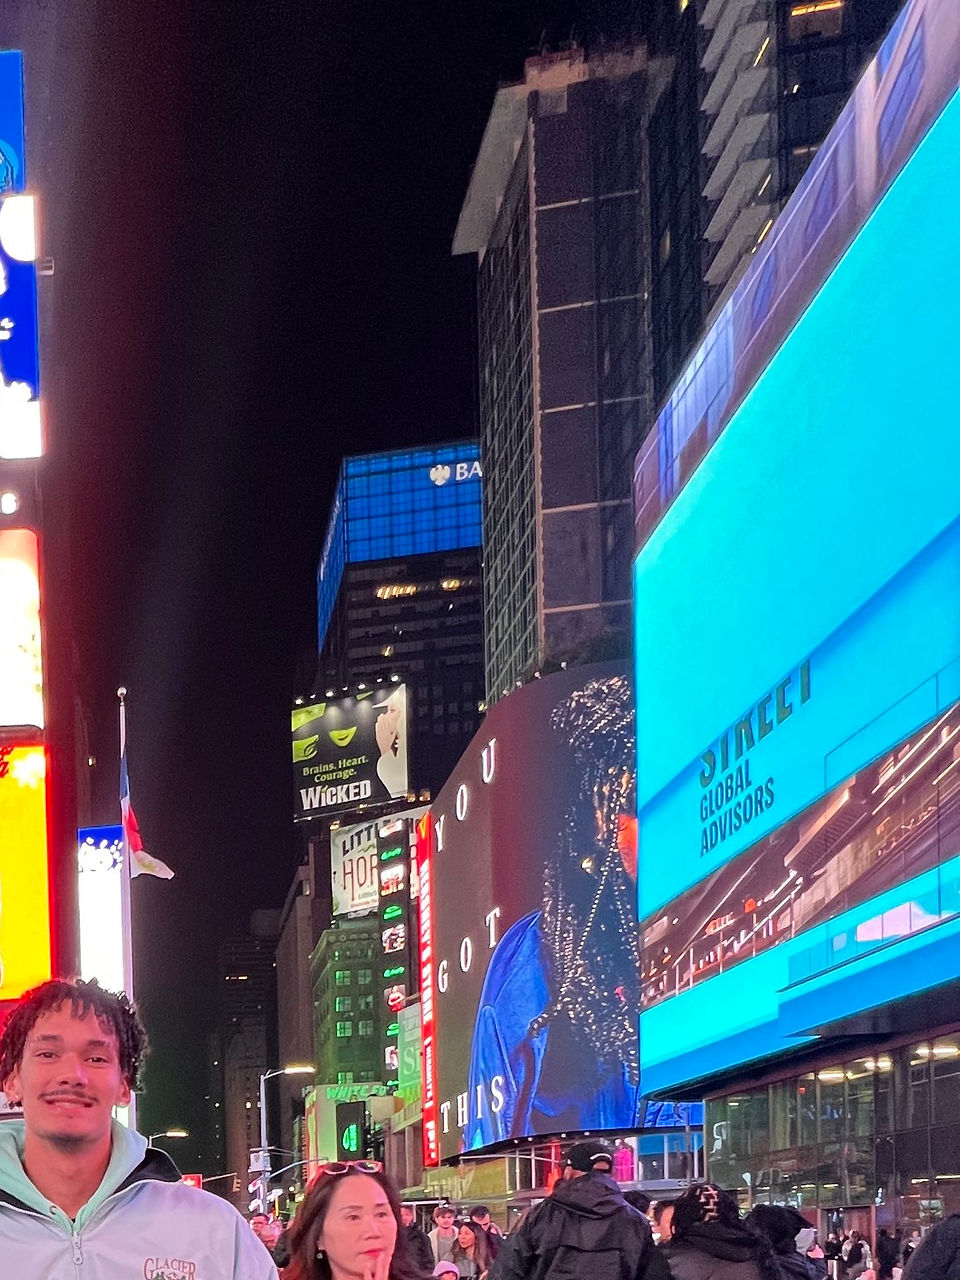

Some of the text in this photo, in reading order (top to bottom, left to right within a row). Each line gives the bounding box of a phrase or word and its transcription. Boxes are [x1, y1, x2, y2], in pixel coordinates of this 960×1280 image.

[303, 755, 369, 777] Brains. Heart.
[314, 768, 358, 784] Courage.
[434, 738, 497, 853] YOU
[700, 758, 752, 823] GLOBAL
[700, 777, 775, 858] ADVISORS
[419, 858, 433, 1025] HERSHEY'S STORE
[438, 907, 500, 993] GOT
[326, 1084, 390, 1100] WHITE FO
[440, 1075, 505, 1134] THIS
